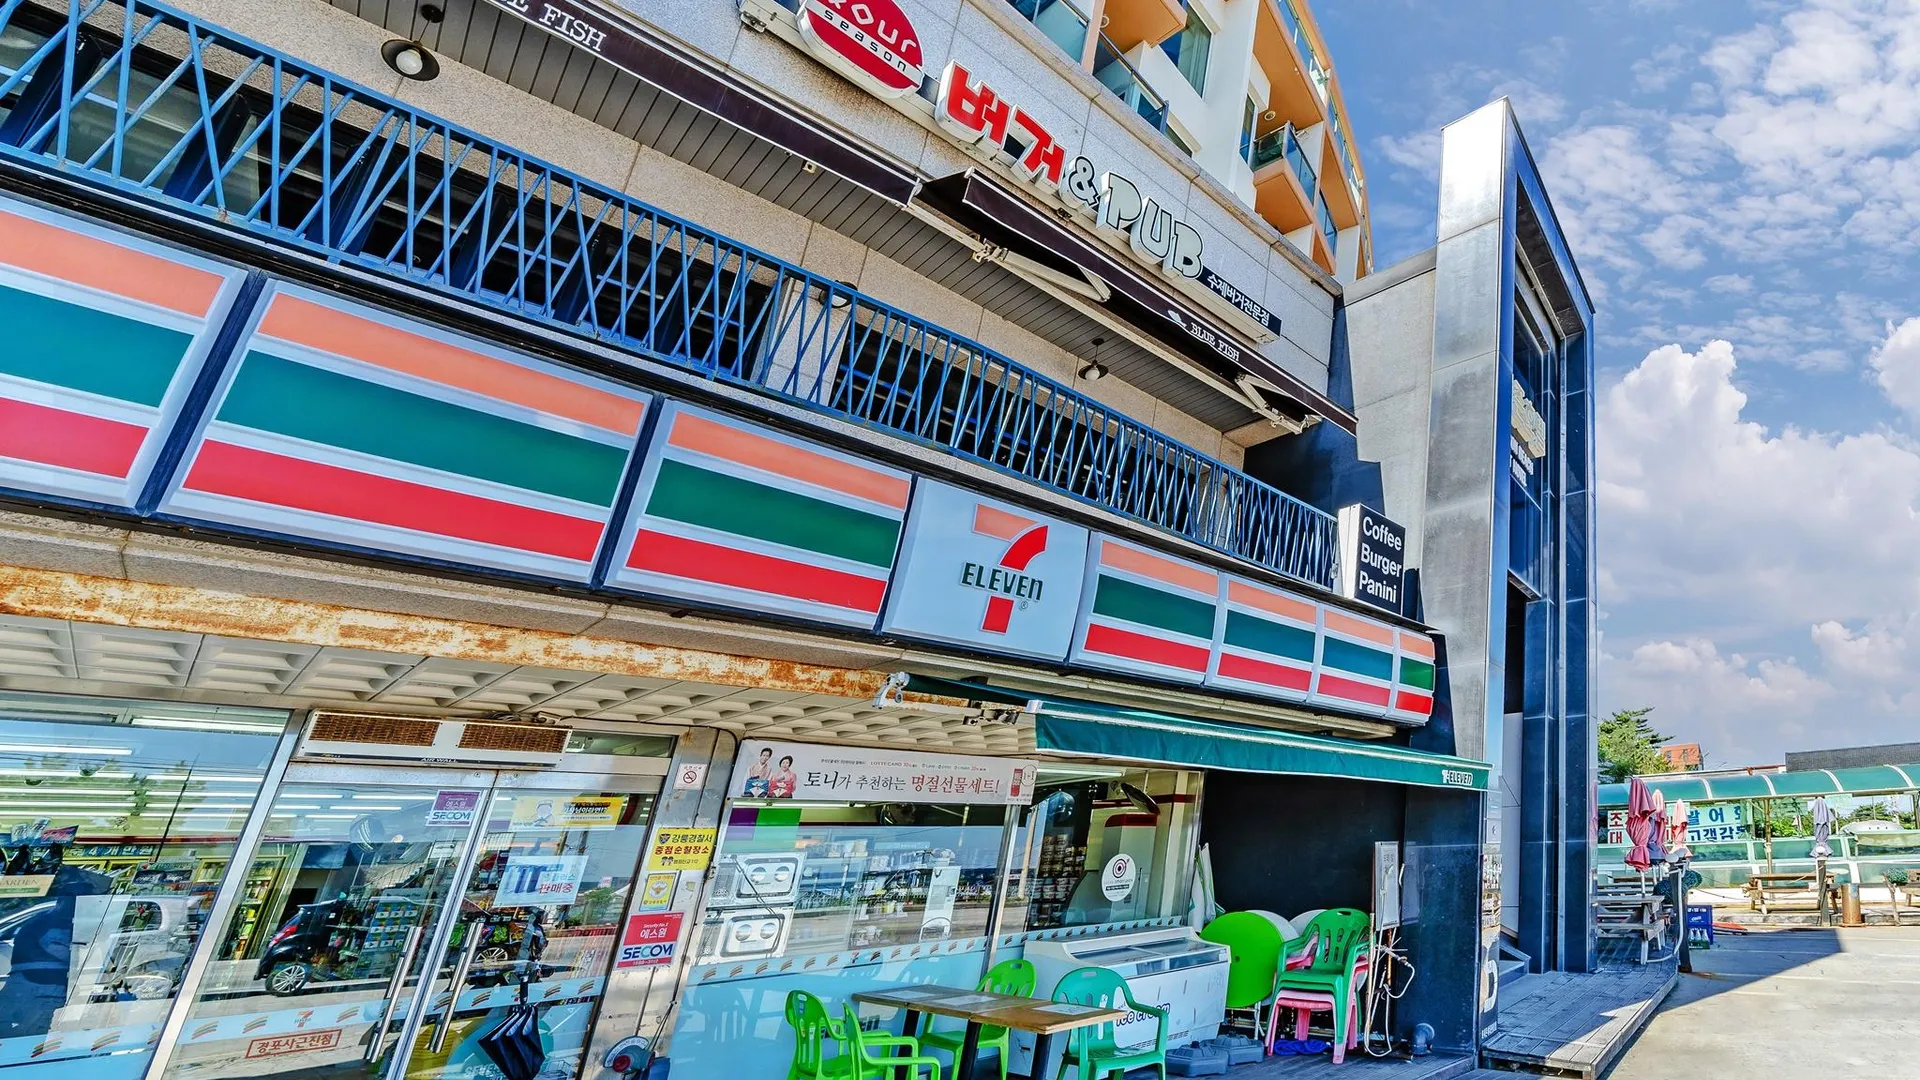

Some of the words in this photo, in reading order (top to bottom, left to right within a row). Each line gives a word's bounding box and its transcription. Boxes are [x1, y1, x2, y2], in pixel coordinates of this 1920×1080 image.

[538, 3, 607, 52] FISH
[824, 9, 907, 72] season
[947, 61, 1066, 186] 버거
[1105, 171, 1204, 281] PUB
[1207, 273, 1271, 328] 수제버거전문점
[1190, 321, 1216, 347] BLUE
[1218, 340, 1240, 362] FISH
[1362, 516, 1402, 551] Coffee
[971, 502, 1049, 636] 7
[1361, 542, 1402, 578] Burger
[1359, 570, 1397, 604] Panini
[803, 770, 852, 790] 토니가
[855, 774, 906, 791] 추천하는
[911, 774, 1000, 795] 명절선물세트!
[432, 811, 472, 820] SECOM
[655, 844, 709, 855] 중점순찰장소
[671, 833, 713, 844] 강릉경찰서
[540, 882, 573, 894] 판매중
[640, 927, 668, 939] 에스원
[622, 943, 674, 960] SECOM
[256, 1033, 334, 1055] 경포사근진점
